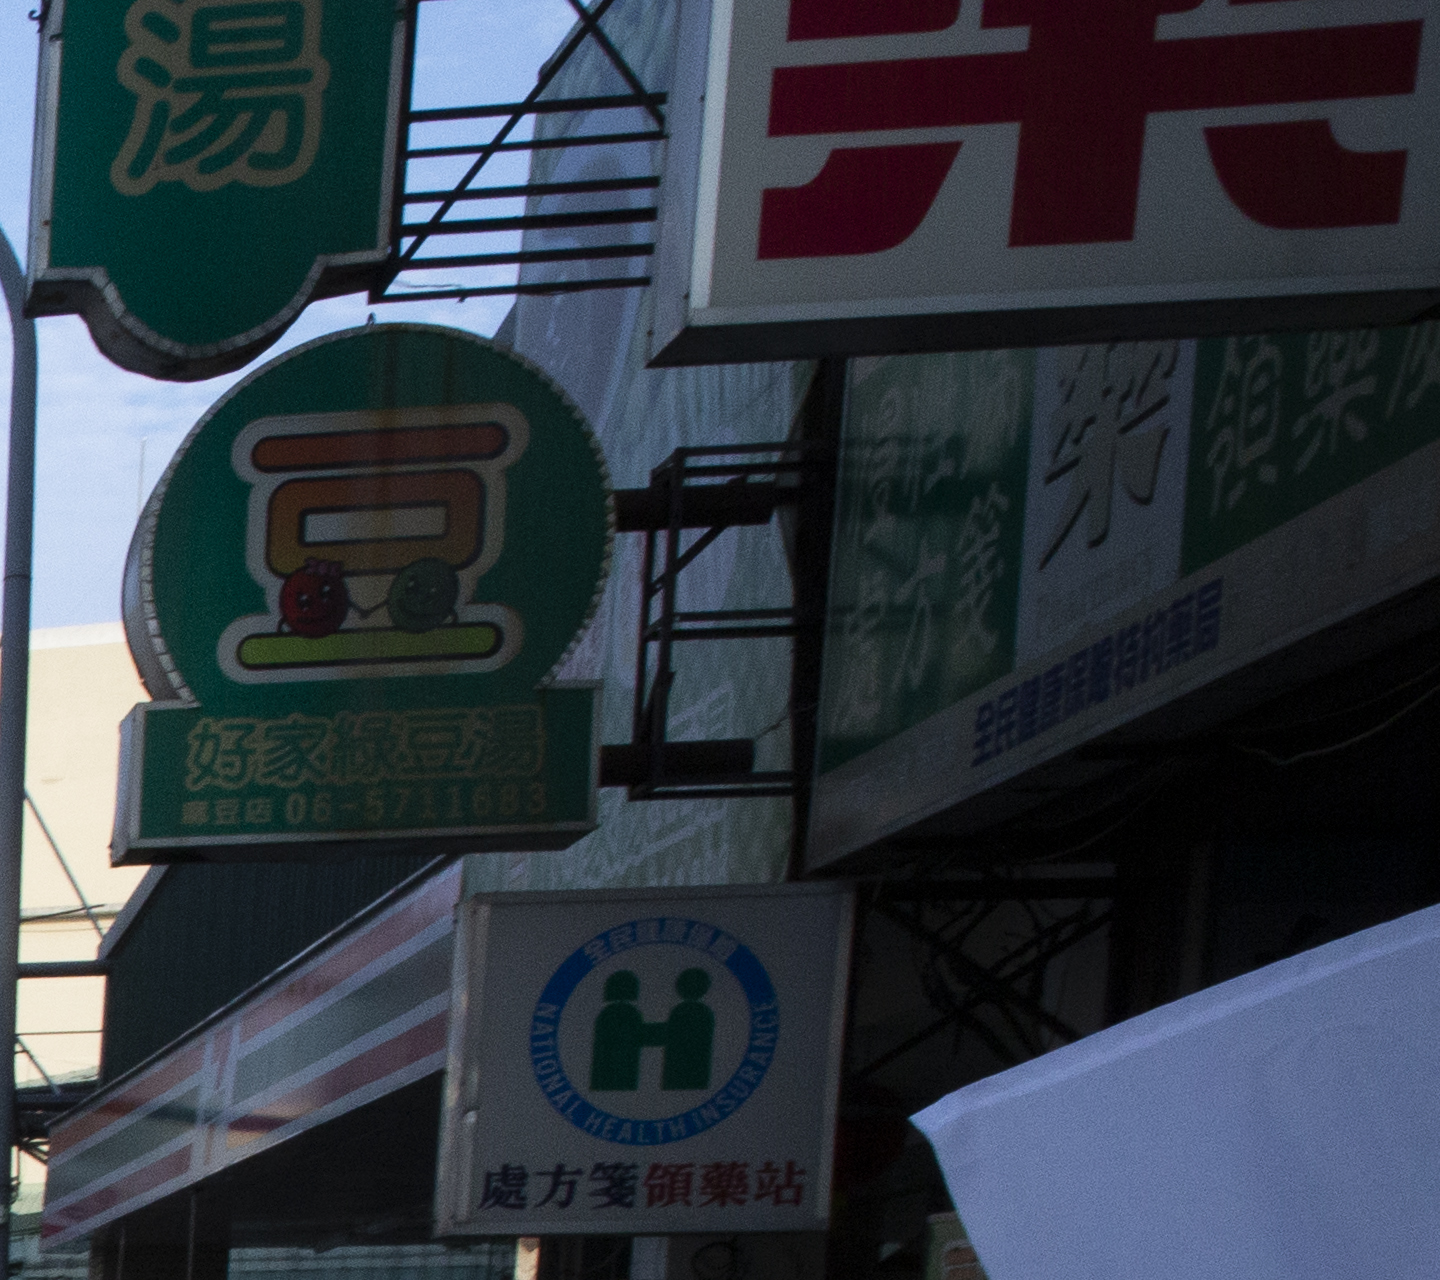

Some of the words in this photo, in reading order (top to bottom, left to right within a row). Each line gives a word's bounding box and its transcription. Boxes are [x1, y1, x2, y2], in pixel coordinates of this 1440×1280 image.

[217, 400, 531, 686] 豆
[582, 1110, 687, 1144] HEALTH
[479, 1160, 807, 1210] 處方箋領藥站
